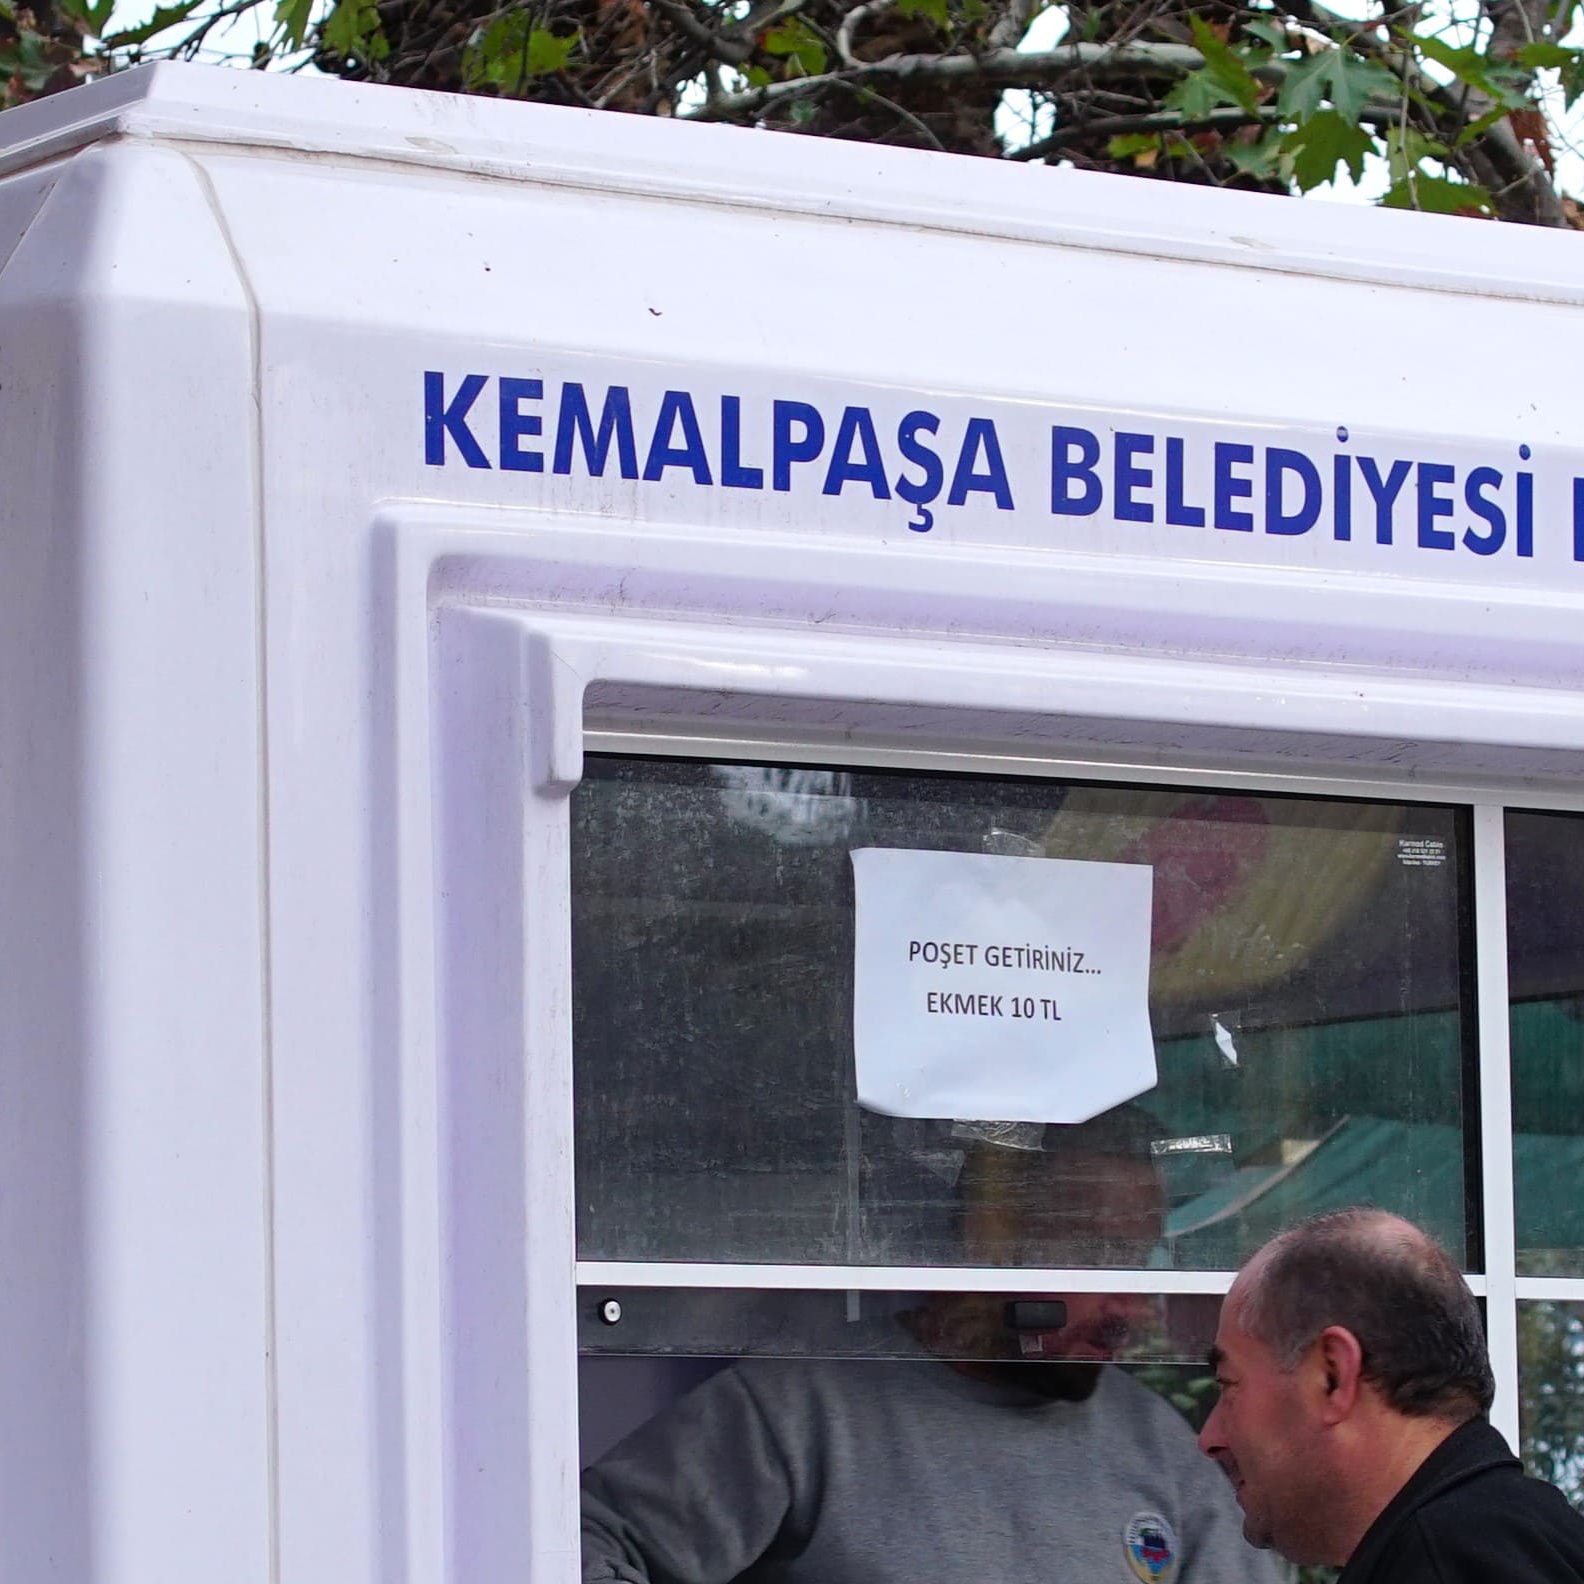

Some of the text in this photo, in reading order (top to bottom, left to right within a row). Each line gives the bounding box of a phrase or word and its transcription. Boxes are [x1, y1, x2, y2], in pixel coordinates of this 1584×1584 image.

[423, 371, 1015, 532] KEMALPAŞA
[1050, 425, 1535, 559] BELEDİYESİ
[909, 941, 1102, 976] POŞET GETİRİNİZ...
[927, 992, 1062, 1021] EKMEK 10 TL
